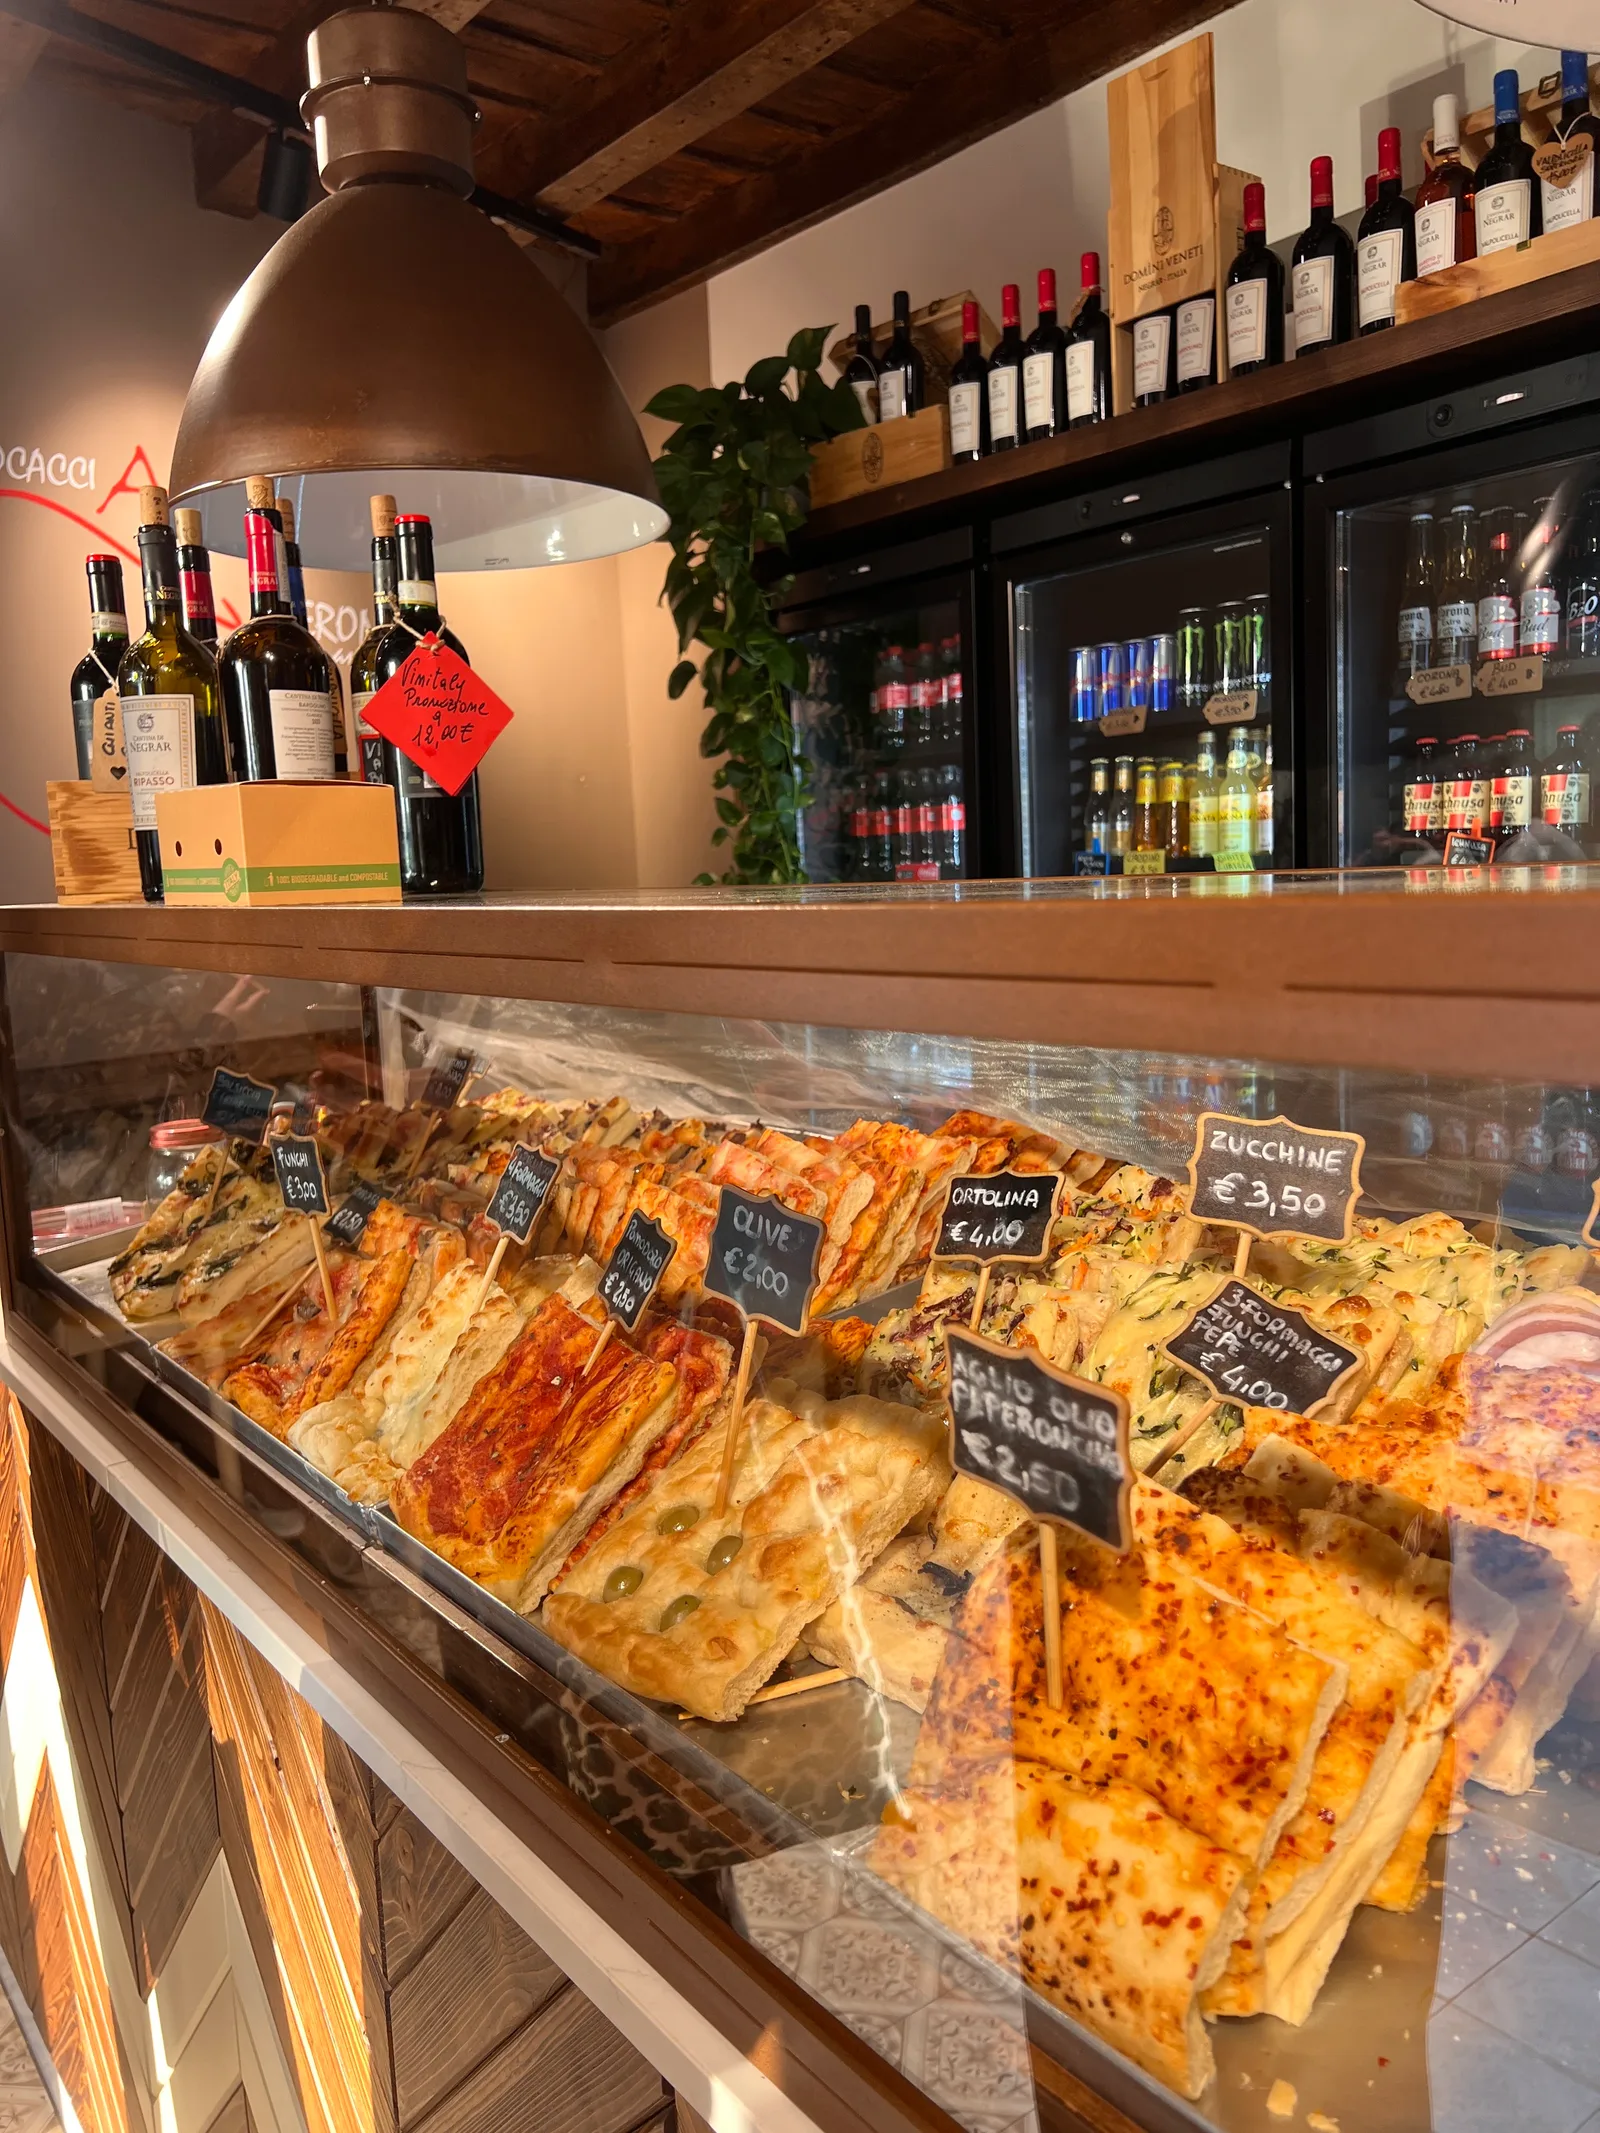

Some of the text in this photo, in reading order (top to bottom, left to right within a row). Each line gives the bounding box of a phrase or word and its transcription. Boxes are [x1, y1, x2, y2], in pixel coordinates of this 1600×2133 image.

[1483, 212, 1515, 228] NEGRAR
[1165, 244, 1204, 272] VENETI
[1521, 617, 1548, 634] Bud
[1493, 663, 1516, 676] BUD
[130, 742, 172, 753] NEGRAR
[134, 777, 175, 787] RIPASSO
[1209, 1130, 1347, 1176] ZUCCHINE
[952, 1187, 1039, 1208] ORTOLINA
[734, 1205, 792, 1252] OLIVE
[616, 1250, 652, 1293] ORIGANO
[1220, 1288, 1244, 1308] 3
[1191, 1316, 1244, 1358] PEPE
[952, 1352, 1116, 1440] AGLIO OLIO
